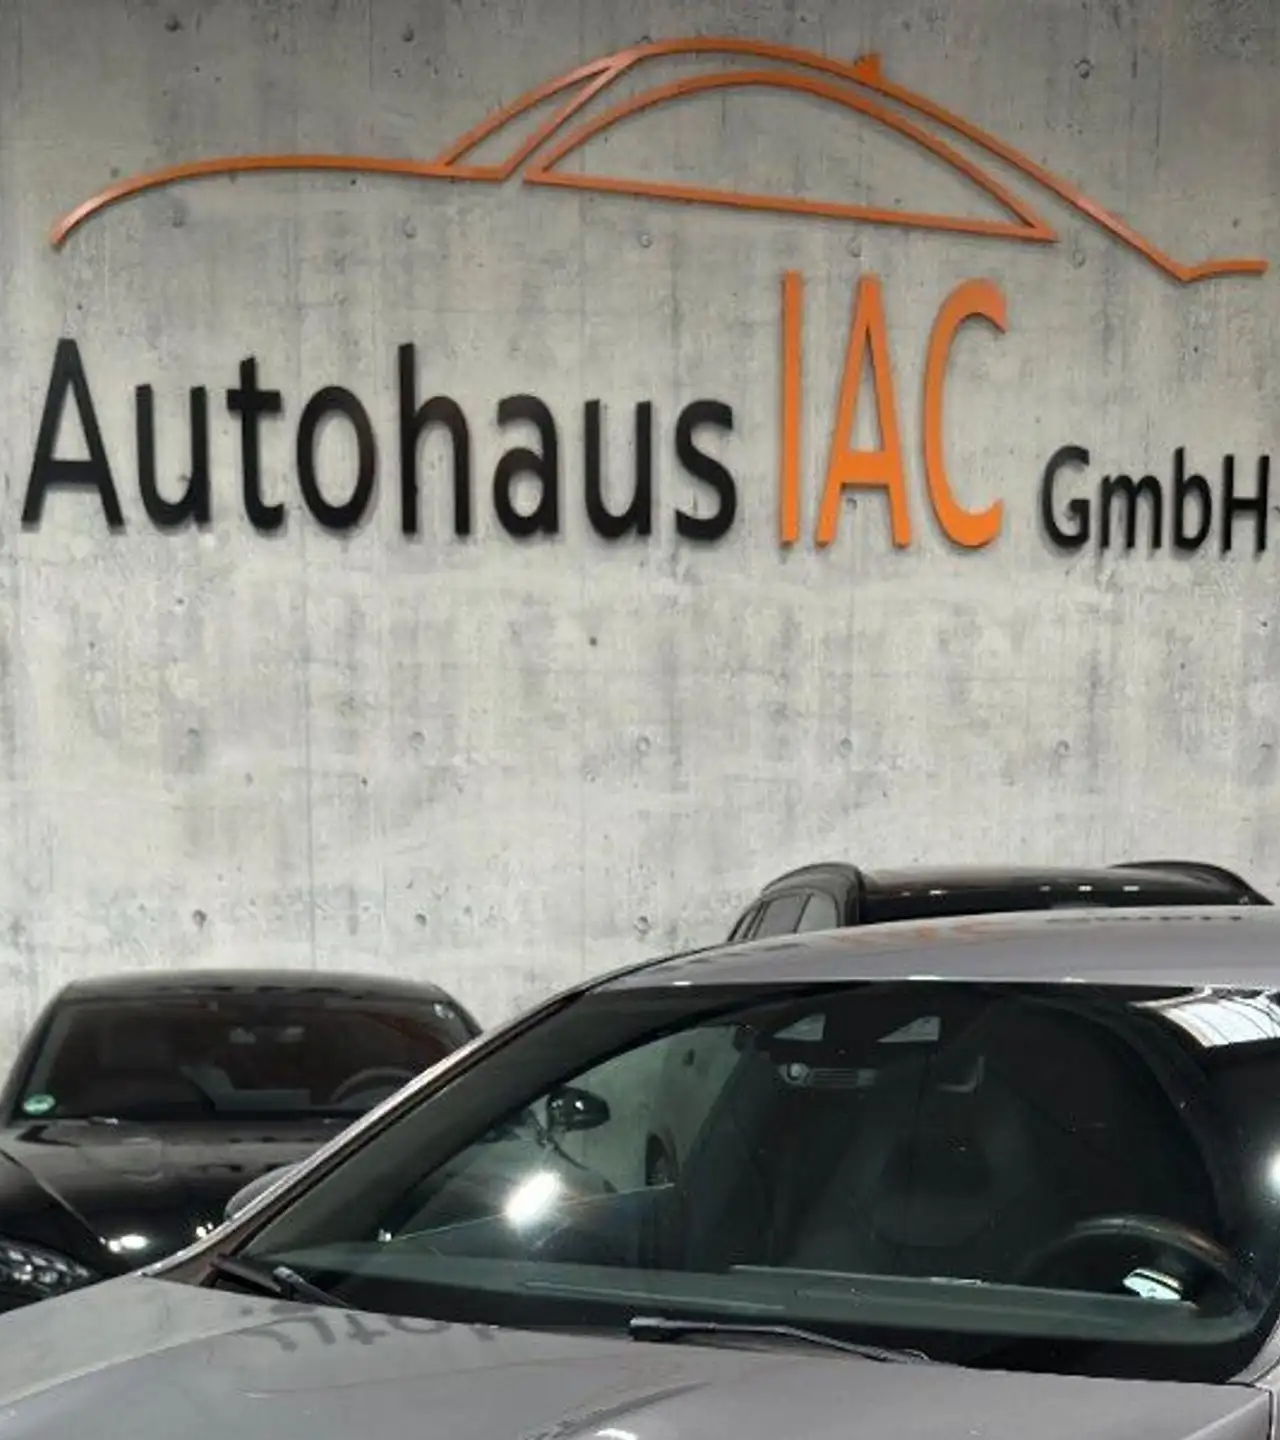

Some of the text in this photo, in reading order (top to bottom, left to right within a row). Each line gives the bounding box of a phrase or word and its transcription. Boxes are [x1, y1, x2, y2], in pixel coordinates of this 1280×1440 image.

[22, 270, 1271, 553] Autohaus IAC GmbH
